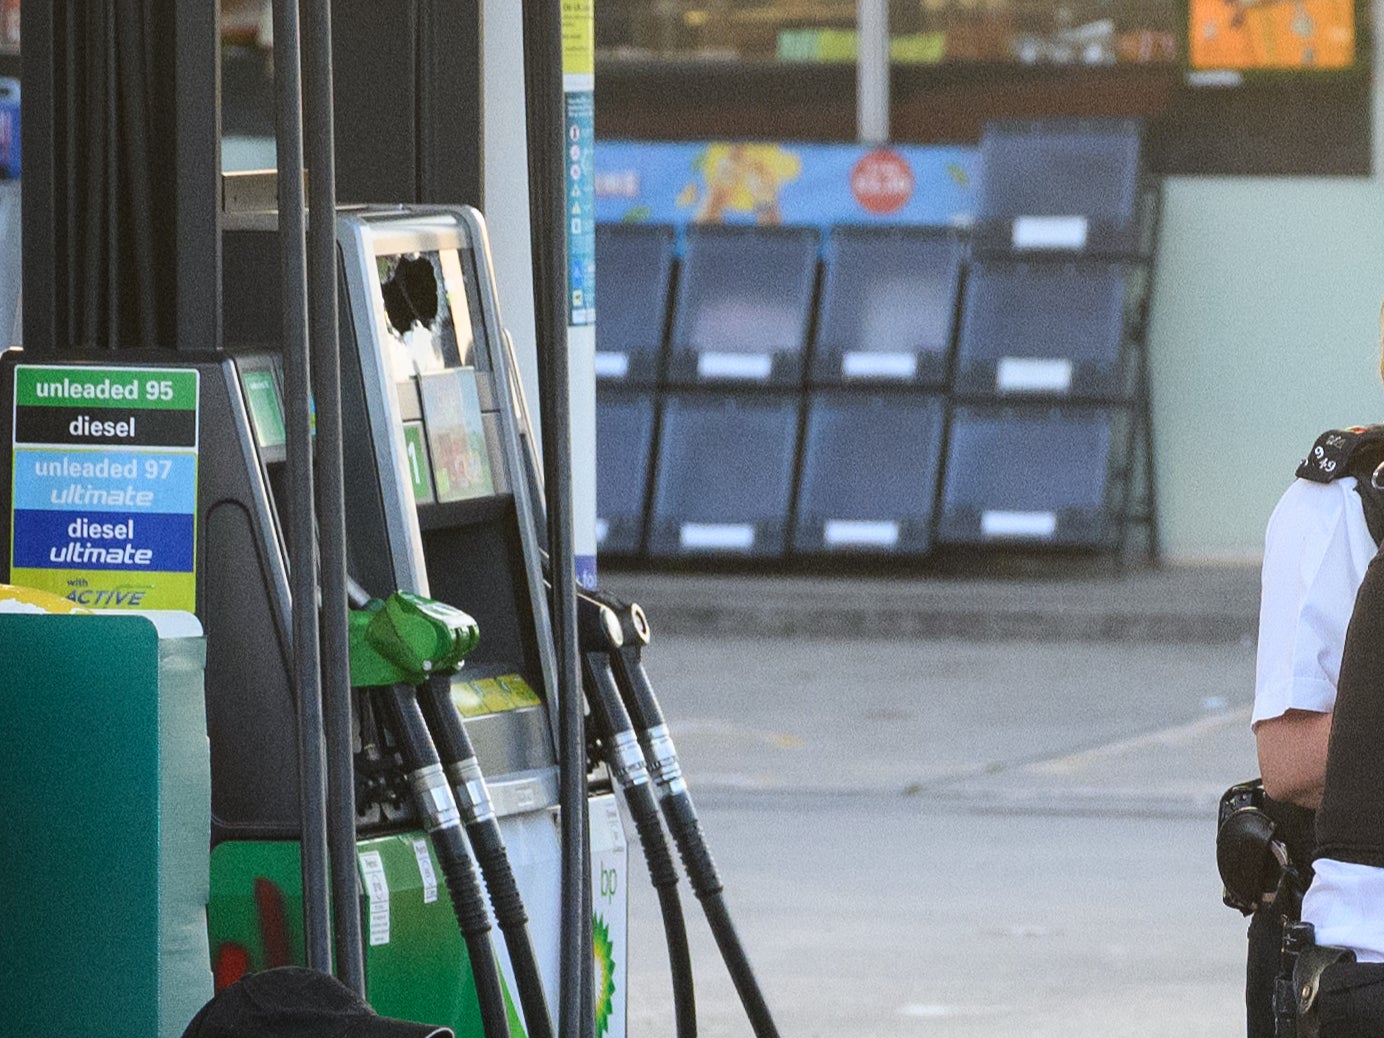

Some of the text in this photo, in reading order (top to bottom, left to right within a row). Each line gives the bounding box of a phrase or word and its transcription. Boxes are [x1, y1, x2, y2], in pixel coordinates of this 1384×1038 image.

[36, 378, 174, 402] unleaded 95
[69, 415, 136, 438] diesel
[34, 456, 173, 481] unleaded 97
[408, 441, 421, 485] 1
[50, 483, 155, 507] ultimate
[67, 518, 134, 541] diesel
[49, 542, 153, 566] ultimate
[67, 577, 89, 588] with
[66, 589, 146, 606] ACTIVE
[599, 860, 618, 906] bp
